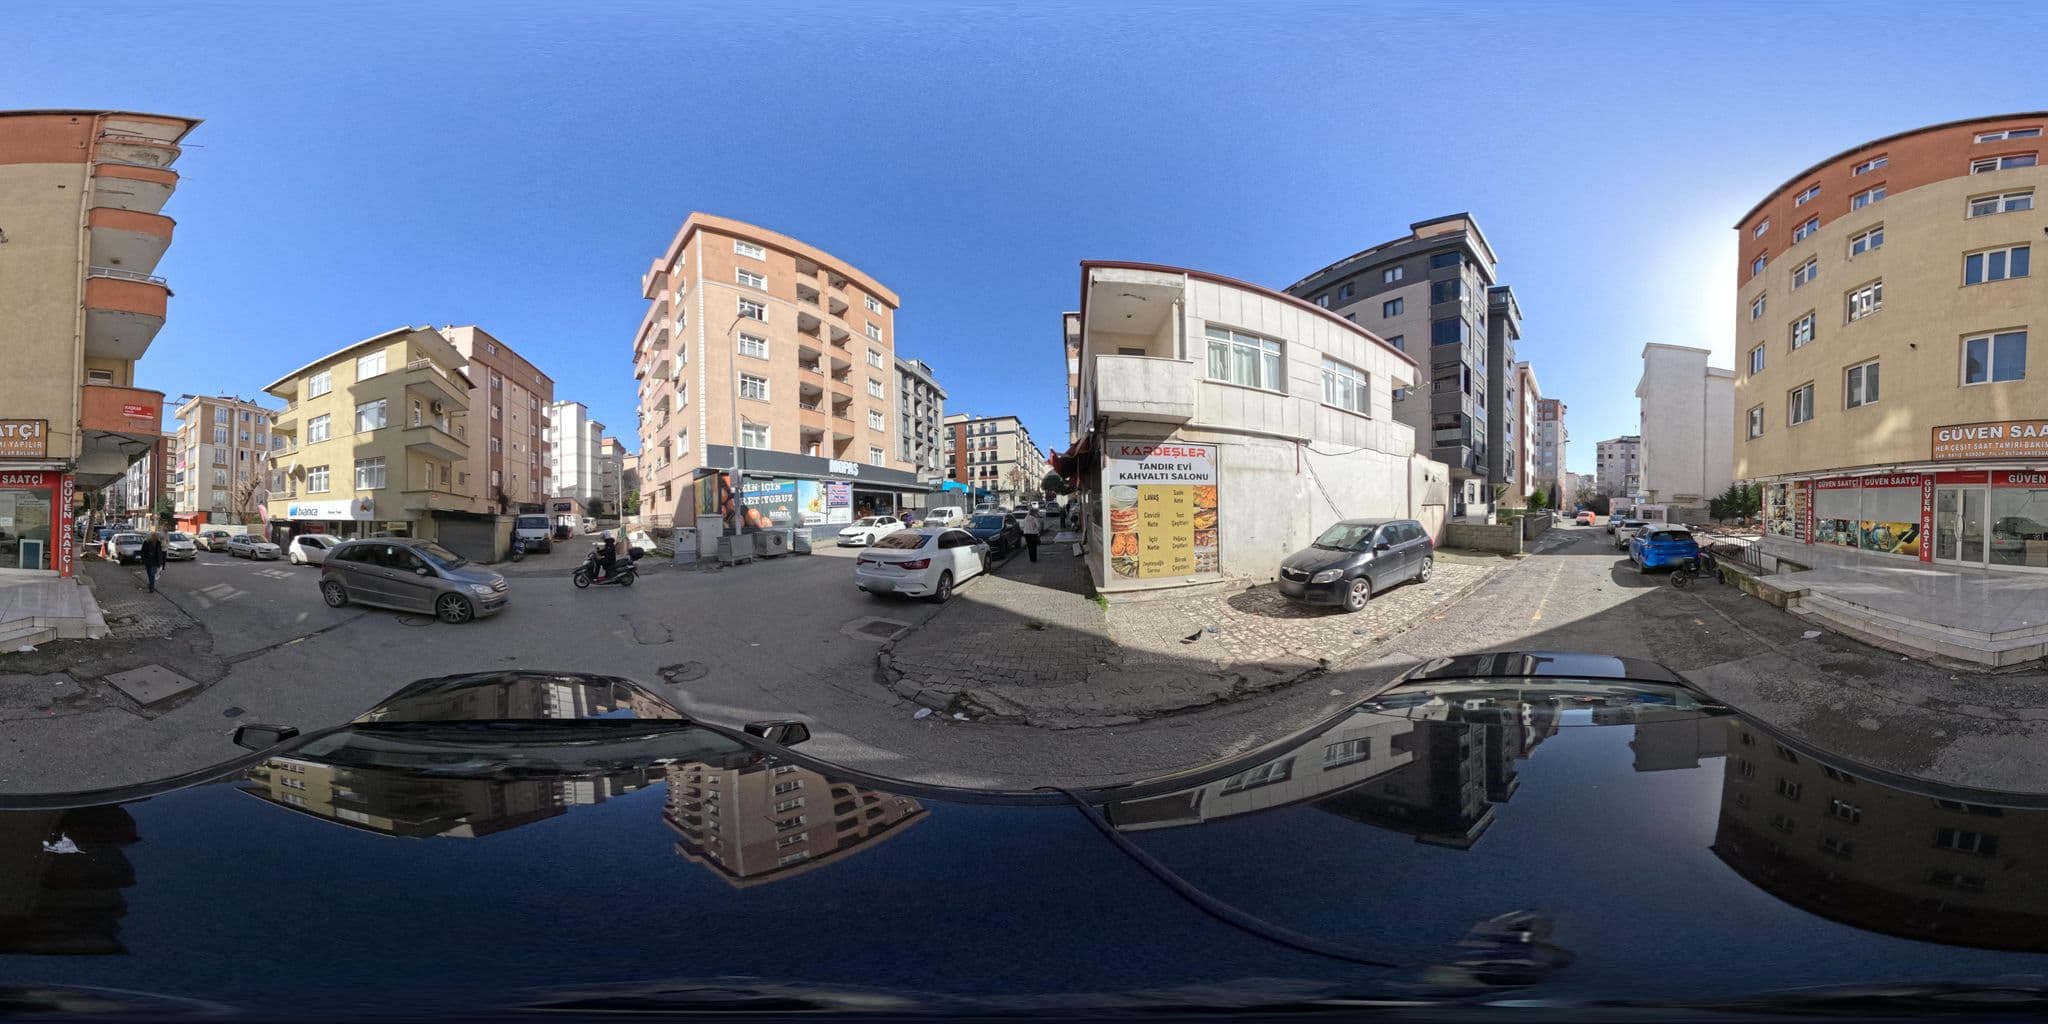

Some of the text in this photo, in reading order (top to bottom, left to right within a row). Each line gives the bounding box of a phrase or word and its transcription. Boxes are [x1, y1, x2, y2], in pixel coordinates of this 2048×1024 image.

[0, 421, 40, 440] TÇİ
[1939, 426, 2003, 442] GÜVEN
[9, 441, 42, 449] YAPILIR
[1973, 442, 1993, 450] SAAT
[1121, 446, 1206, 459] KARDEŞLER
[1138, 462, 1192, 471] TANDIR EVİ
[2, 472, 43, 486] SAATÇİ
[1120, 472, 1168, 480] KAHVALTI
[1864, 475, 1919, 486] GÜVEN SAATÇİ
[2008, 474, 2046, 484] GÜVEN
[1818, 479, 1859, 488] GÜVEN SAATÇİ
[741, 494, 793, 505] RETİYORUZ
[1923, 479, 1932, 558] GÜVEN SAATÇİ
[63, 480, 73, 573] GÜVEN SAATÇİ
